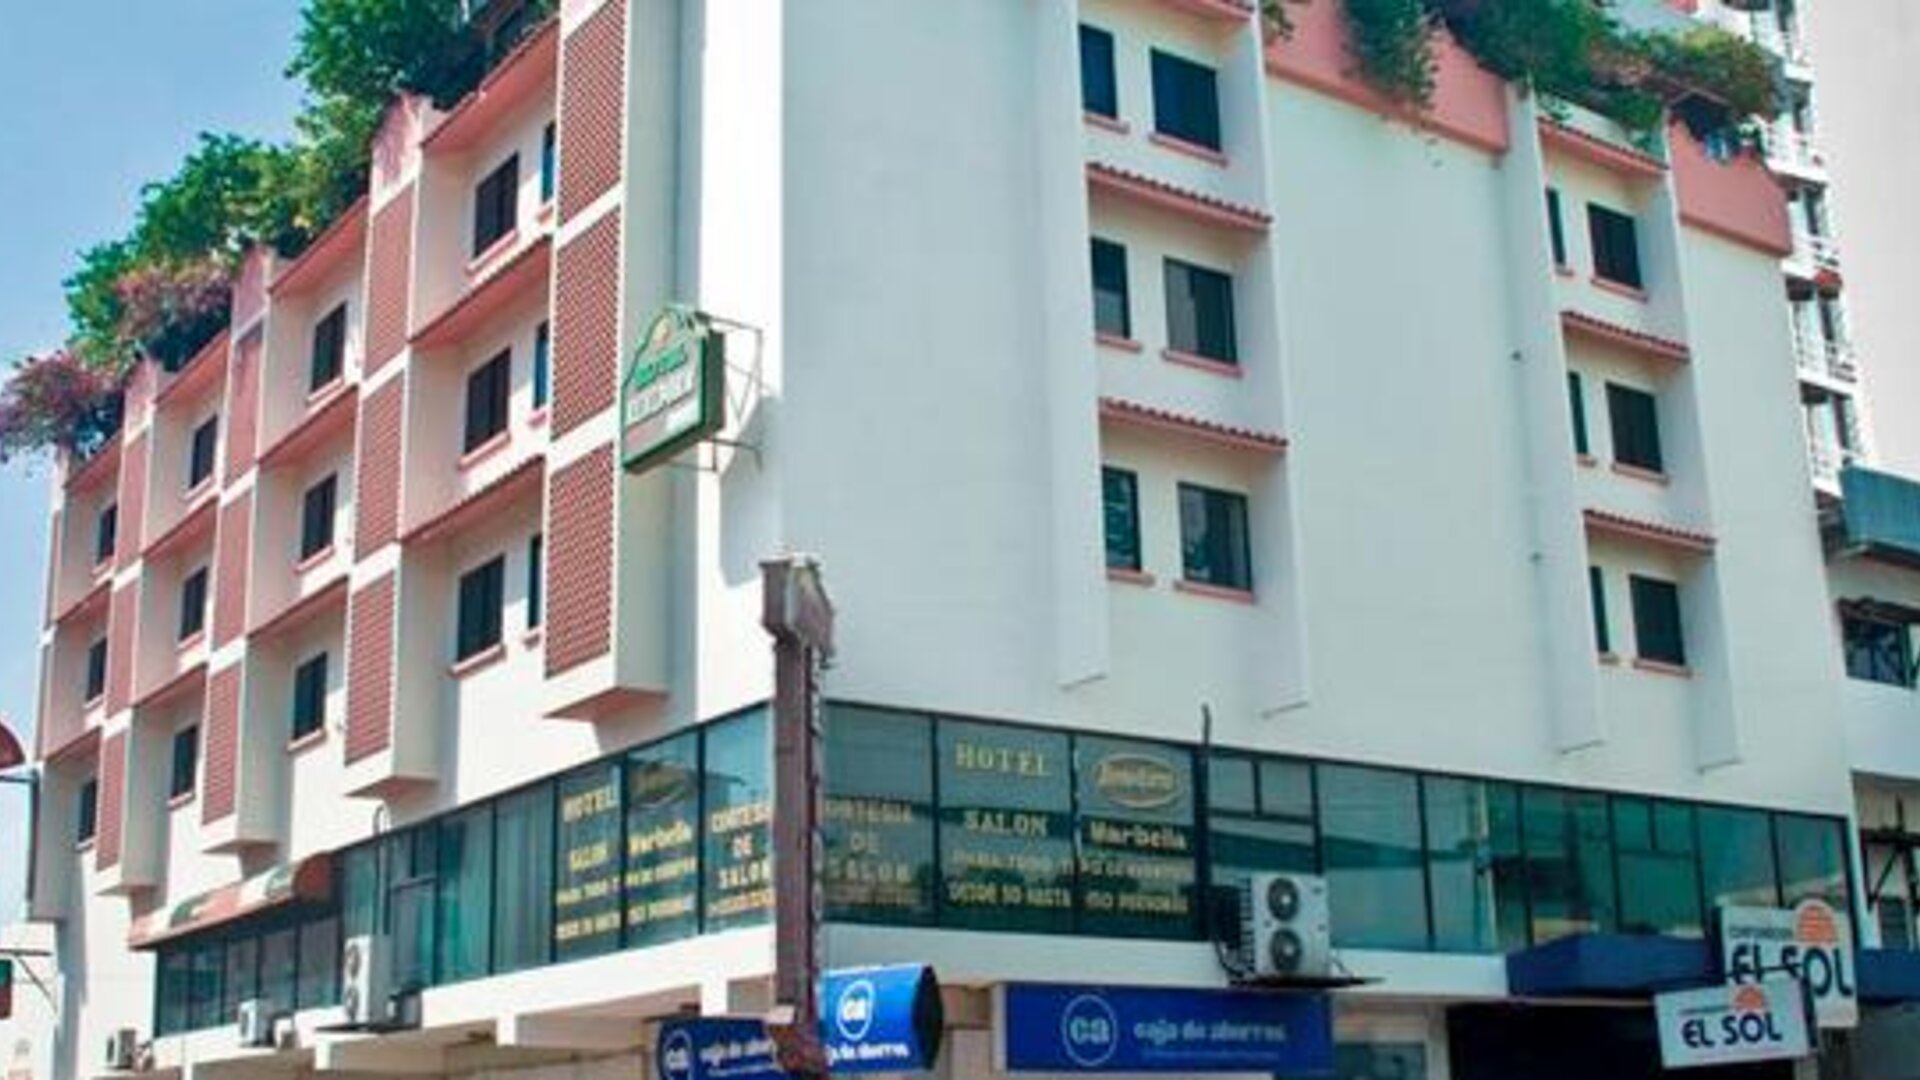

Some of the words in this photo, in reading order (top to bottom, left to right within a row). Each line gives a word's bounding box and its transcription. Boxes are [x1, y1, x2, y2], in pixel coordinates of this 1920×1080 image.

[956, 743, 1050, 776] HOTEL
[563, 784, 619, 822] HOTEL
[964, 811, 1047, 836] SALON
[1090, 821, 1187, 850] Marbella
[1682, 1018, 1715, 1048] EL
[1720, 1013, 1783, 1045] SOL
